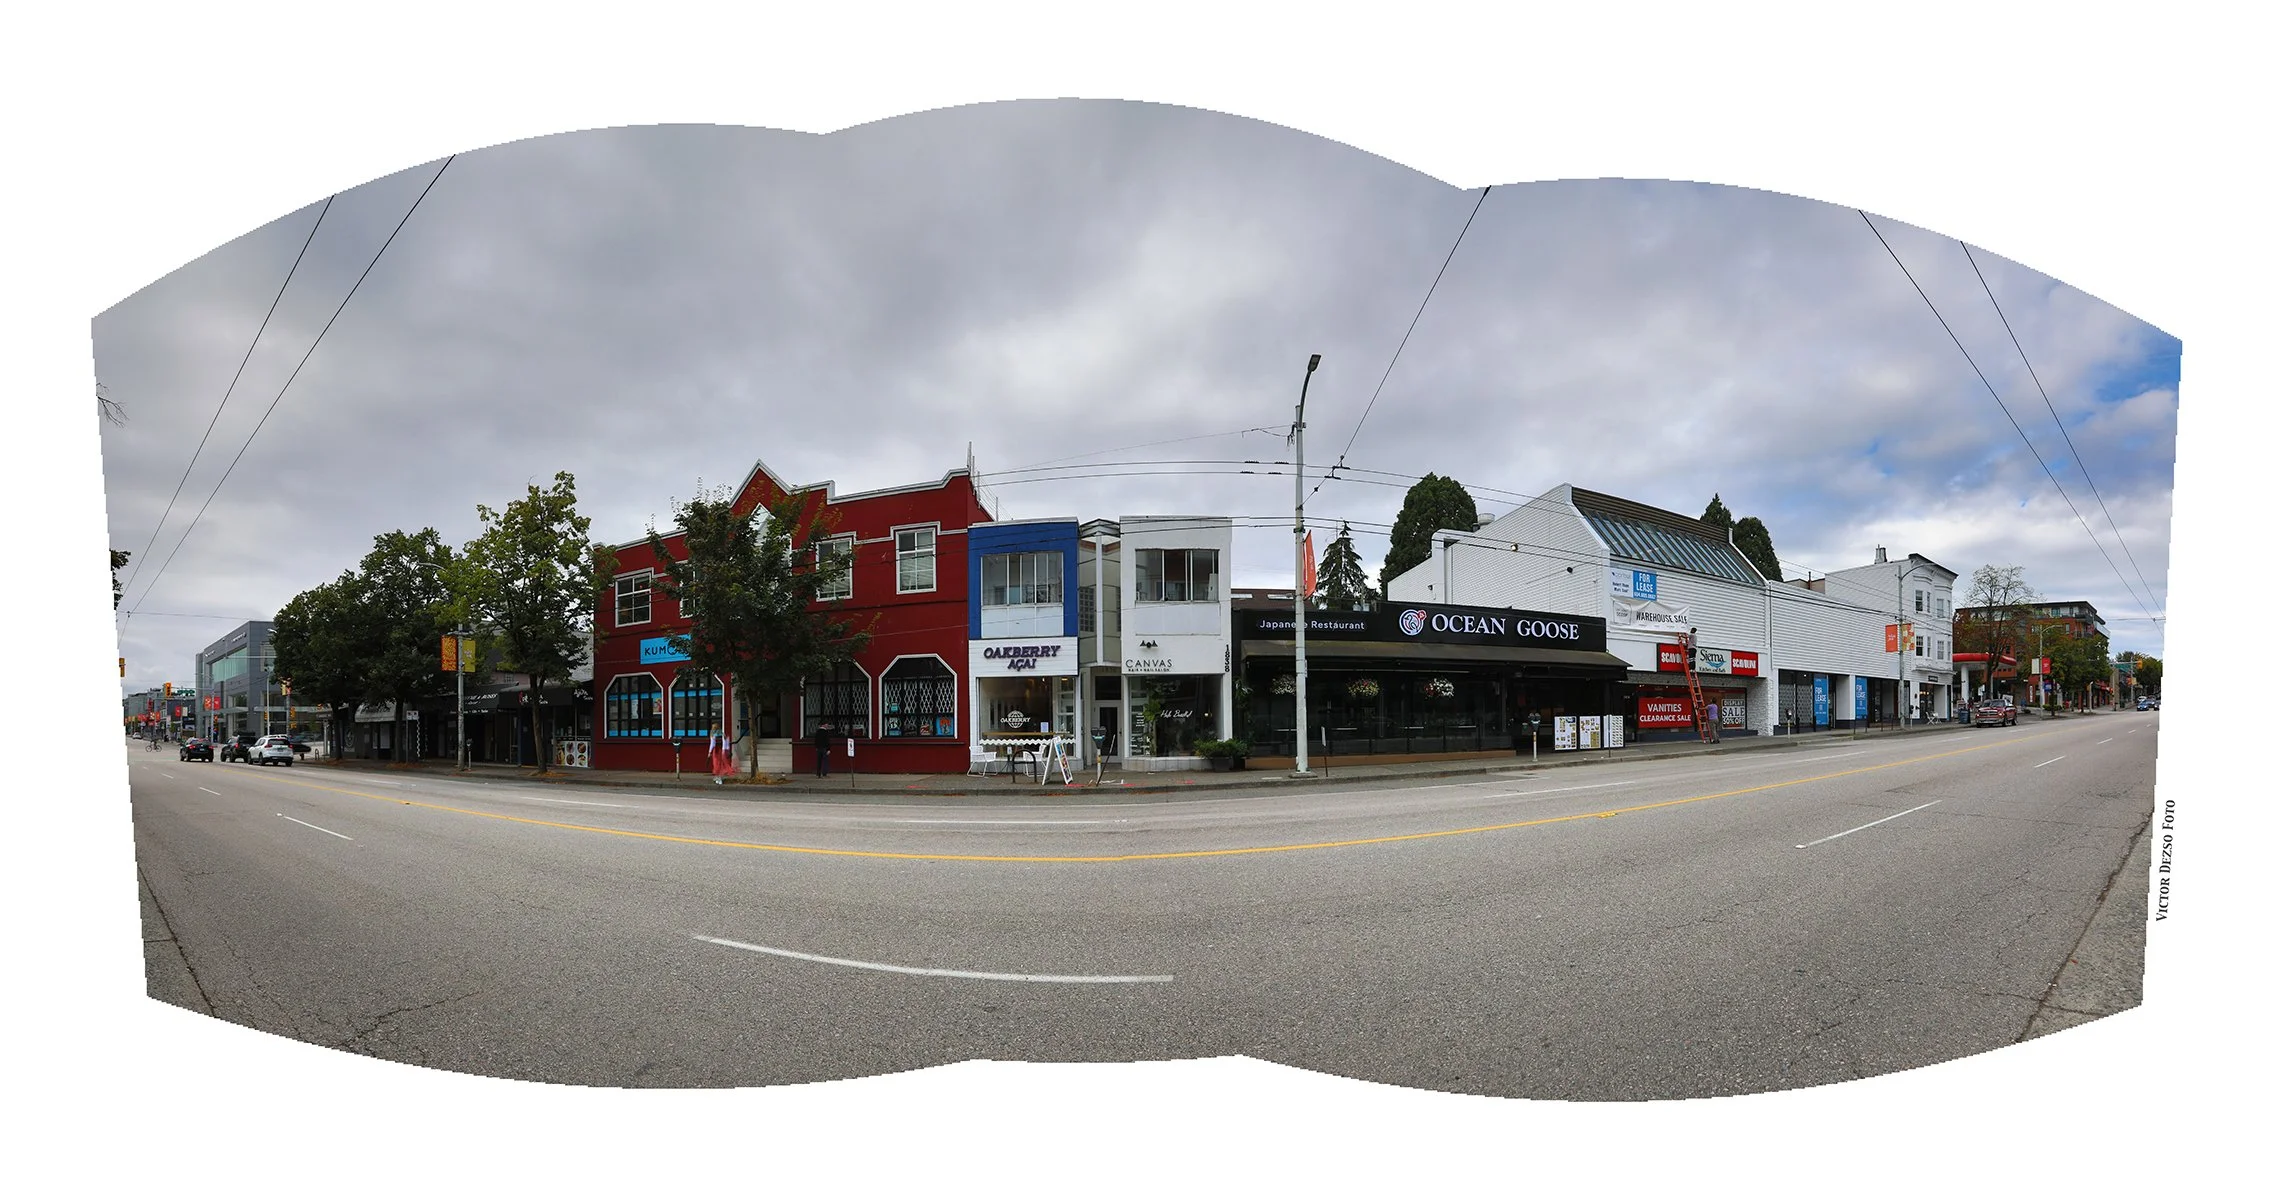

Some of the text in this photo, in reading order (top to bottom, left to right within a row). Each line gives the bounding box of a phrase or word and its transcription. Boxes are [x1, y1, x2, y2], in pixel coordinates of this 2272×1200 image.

[1639, 573, 1650, 583] FOR
[1636, 582, 1654, 593] LEASE
[1636, 612, 1688, 624] WAREHOUSE SALE
[1260, 620, 1364, 630] Japanee Restaurant
[1432, 614, 1580, 640] OCEAN GOOSE
[984, 646, 1061, 659] OAKBERRY
[1008, 659, 1036, 672] AÇAI
[1126, 659, 1172, 668] CANVAS
[1648, 704, 1682, 712] VANITIES
[1722, 708, 1744, 716] SALE
